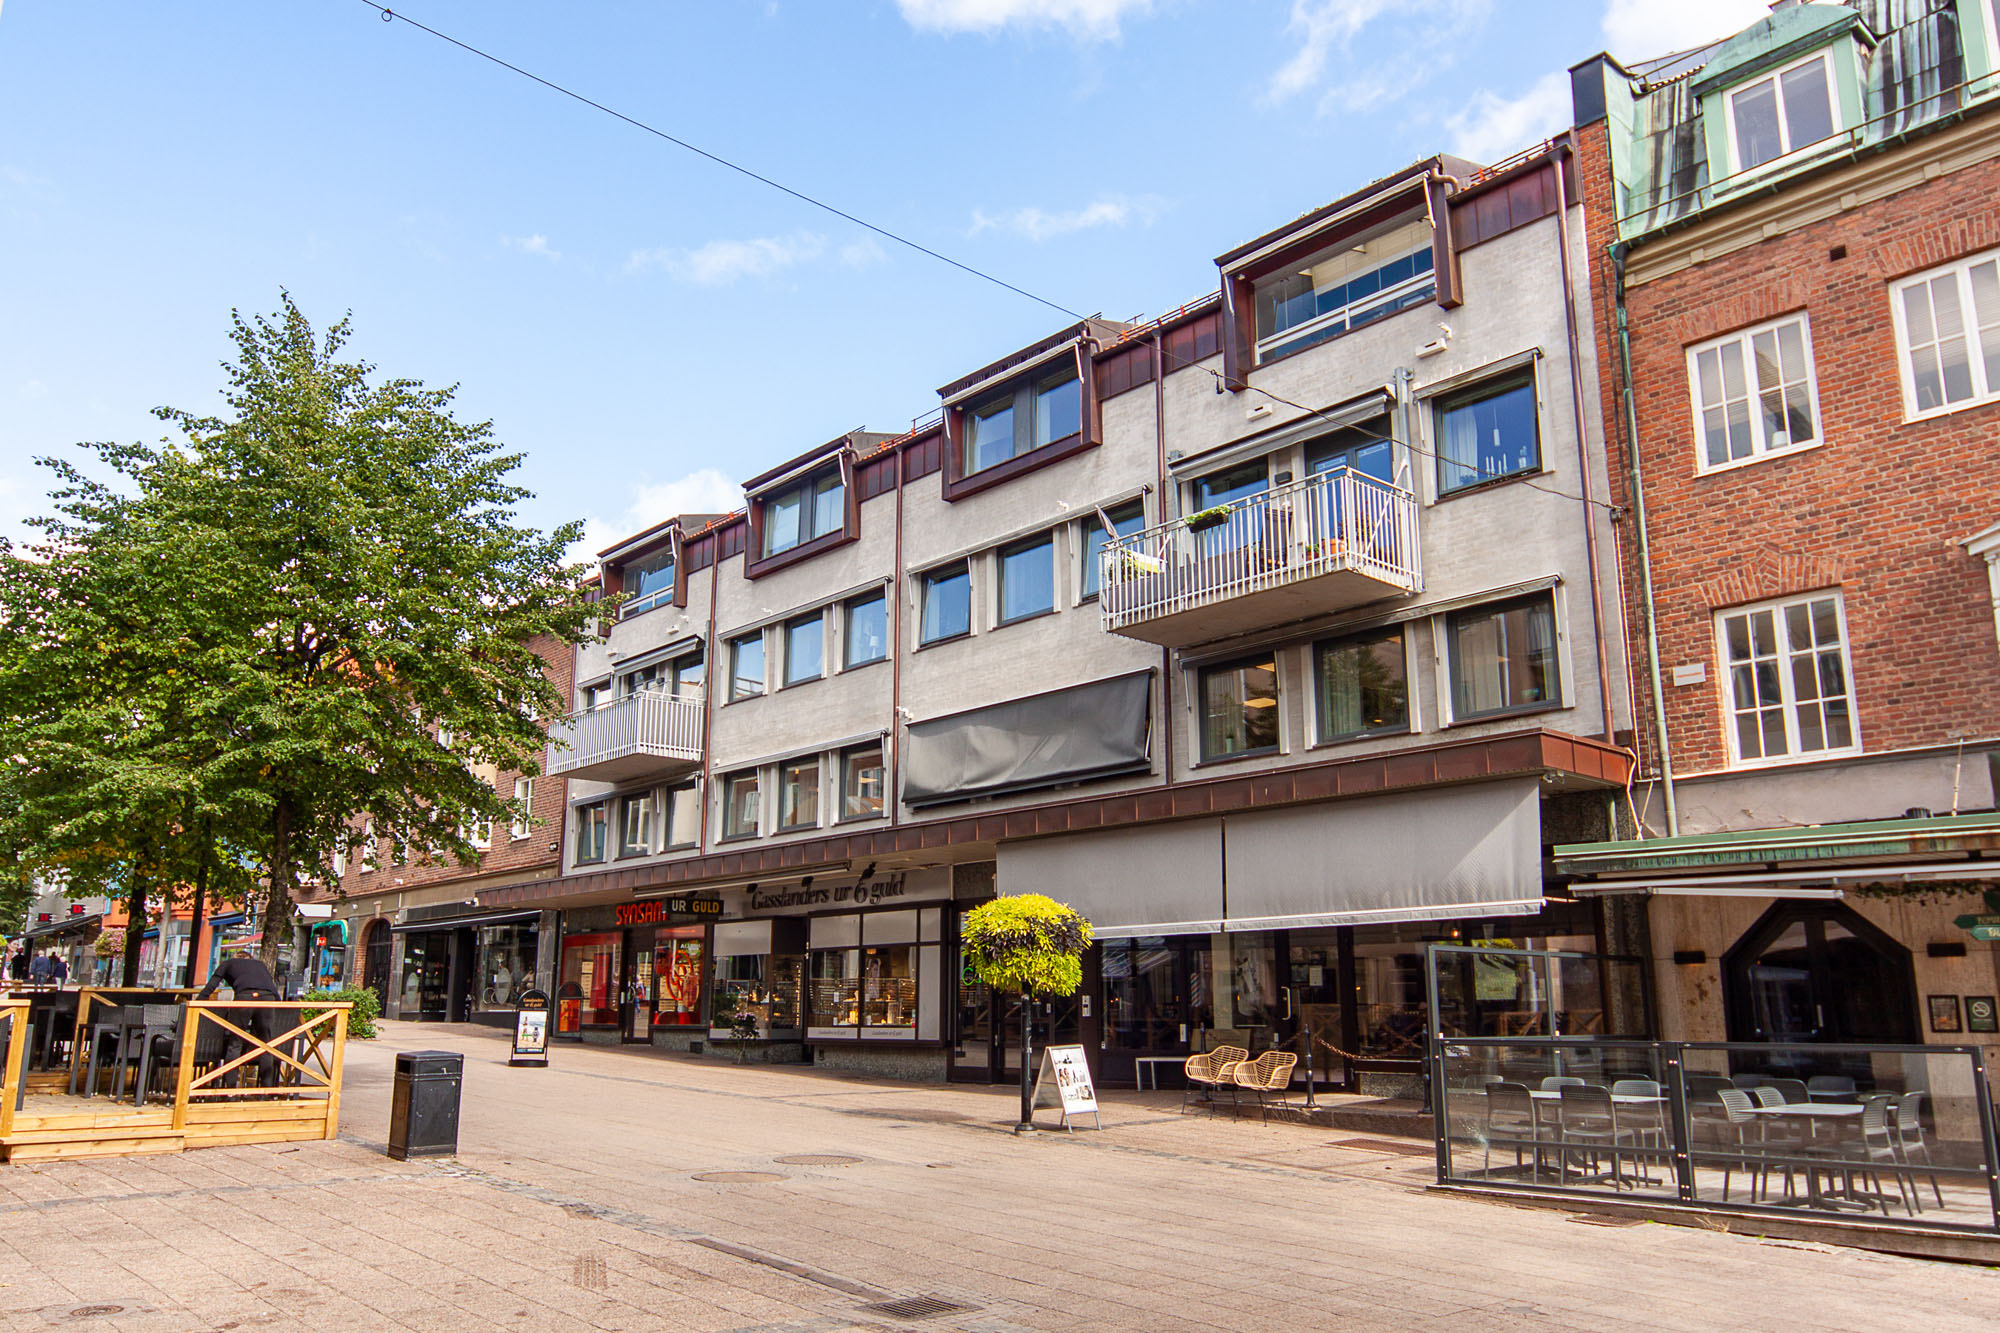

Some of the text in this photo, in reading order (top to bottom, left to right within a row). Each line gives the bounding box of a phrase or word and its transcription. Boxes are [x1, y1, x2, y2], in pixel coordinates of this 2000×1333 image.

[833, 885, 853, 902] ur
[869, 873, 906, 905] guld
[671, 899, 720, 913] UR GULD
